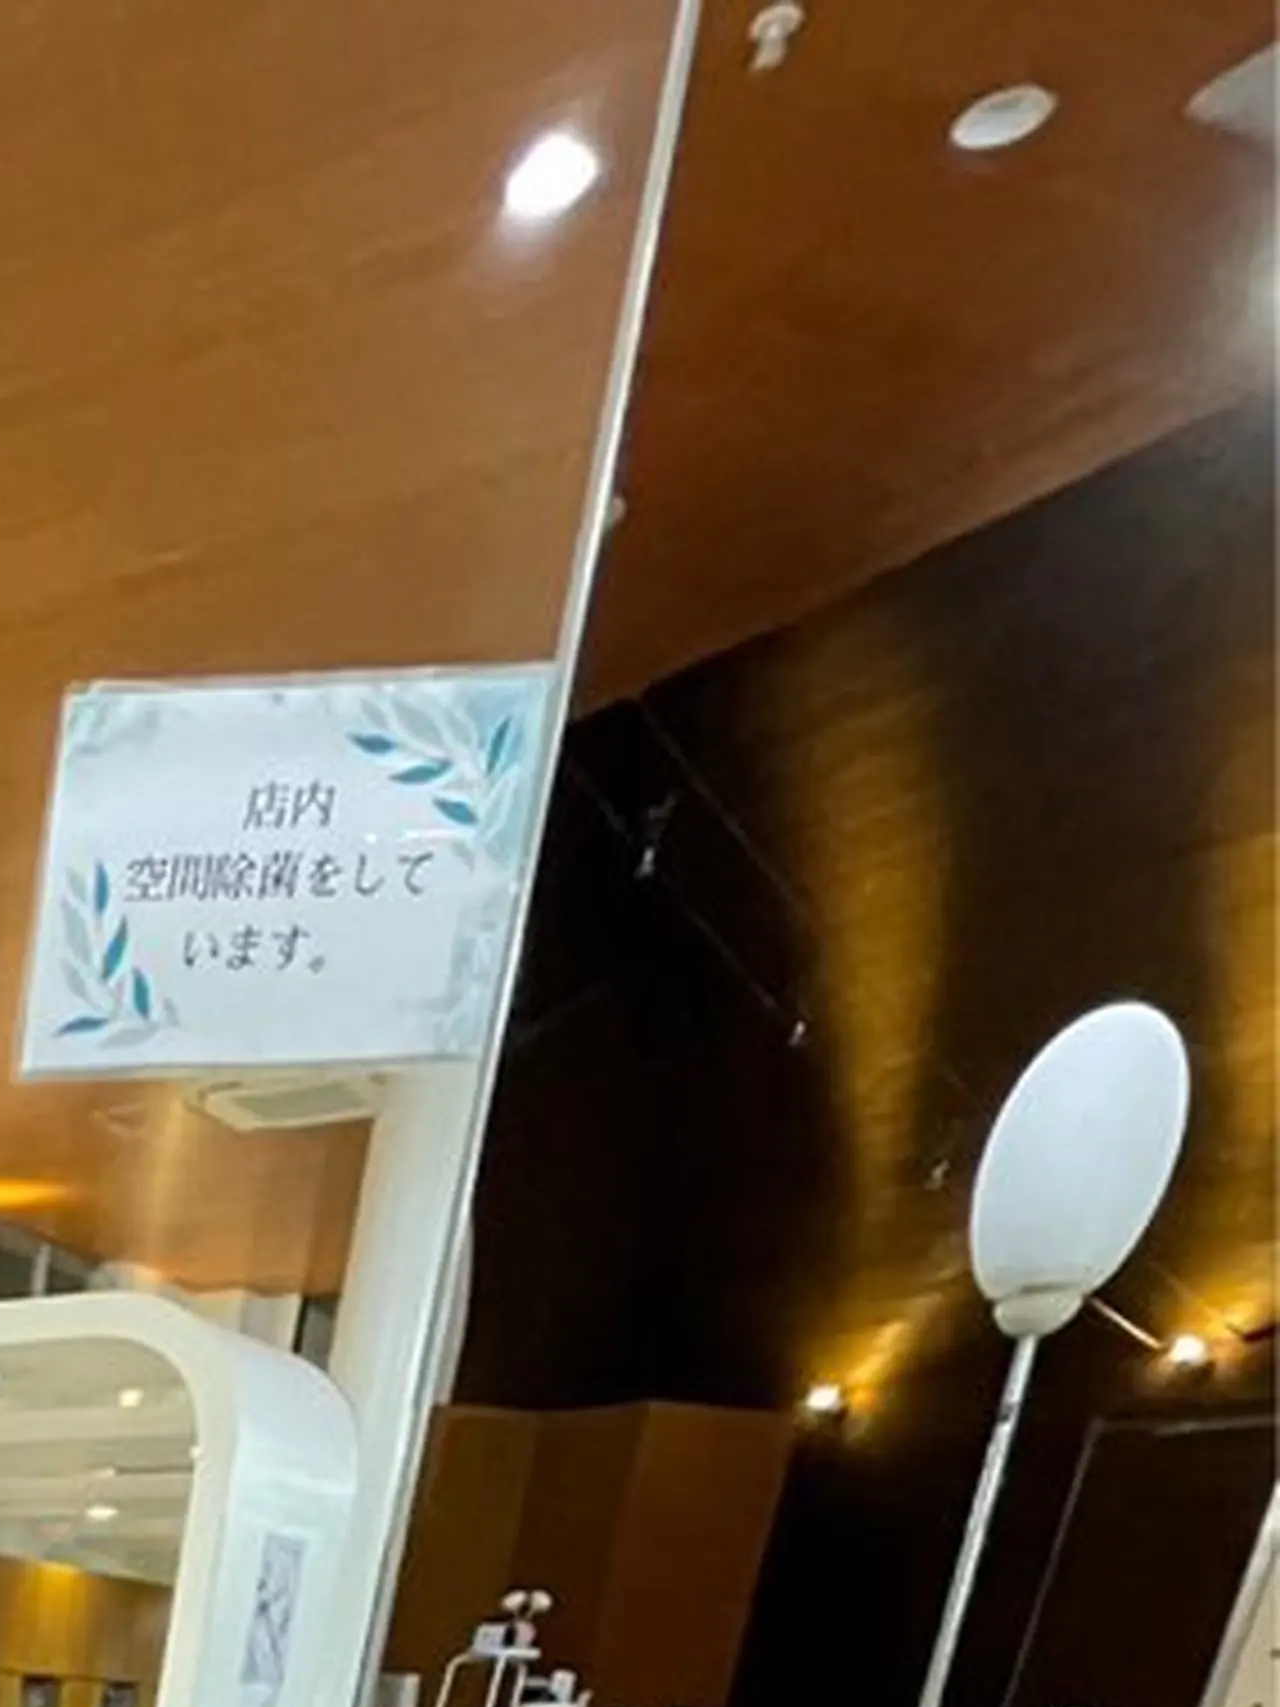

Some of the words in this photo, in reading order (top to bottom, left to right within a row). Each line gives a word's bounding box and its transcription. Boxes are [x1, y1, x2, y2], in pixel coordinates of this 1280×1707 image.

[242, 780, 337, 829] 店内
[124, 851, 434, 901] 空間除菌をして
[183, 923, 326, 973] います。
